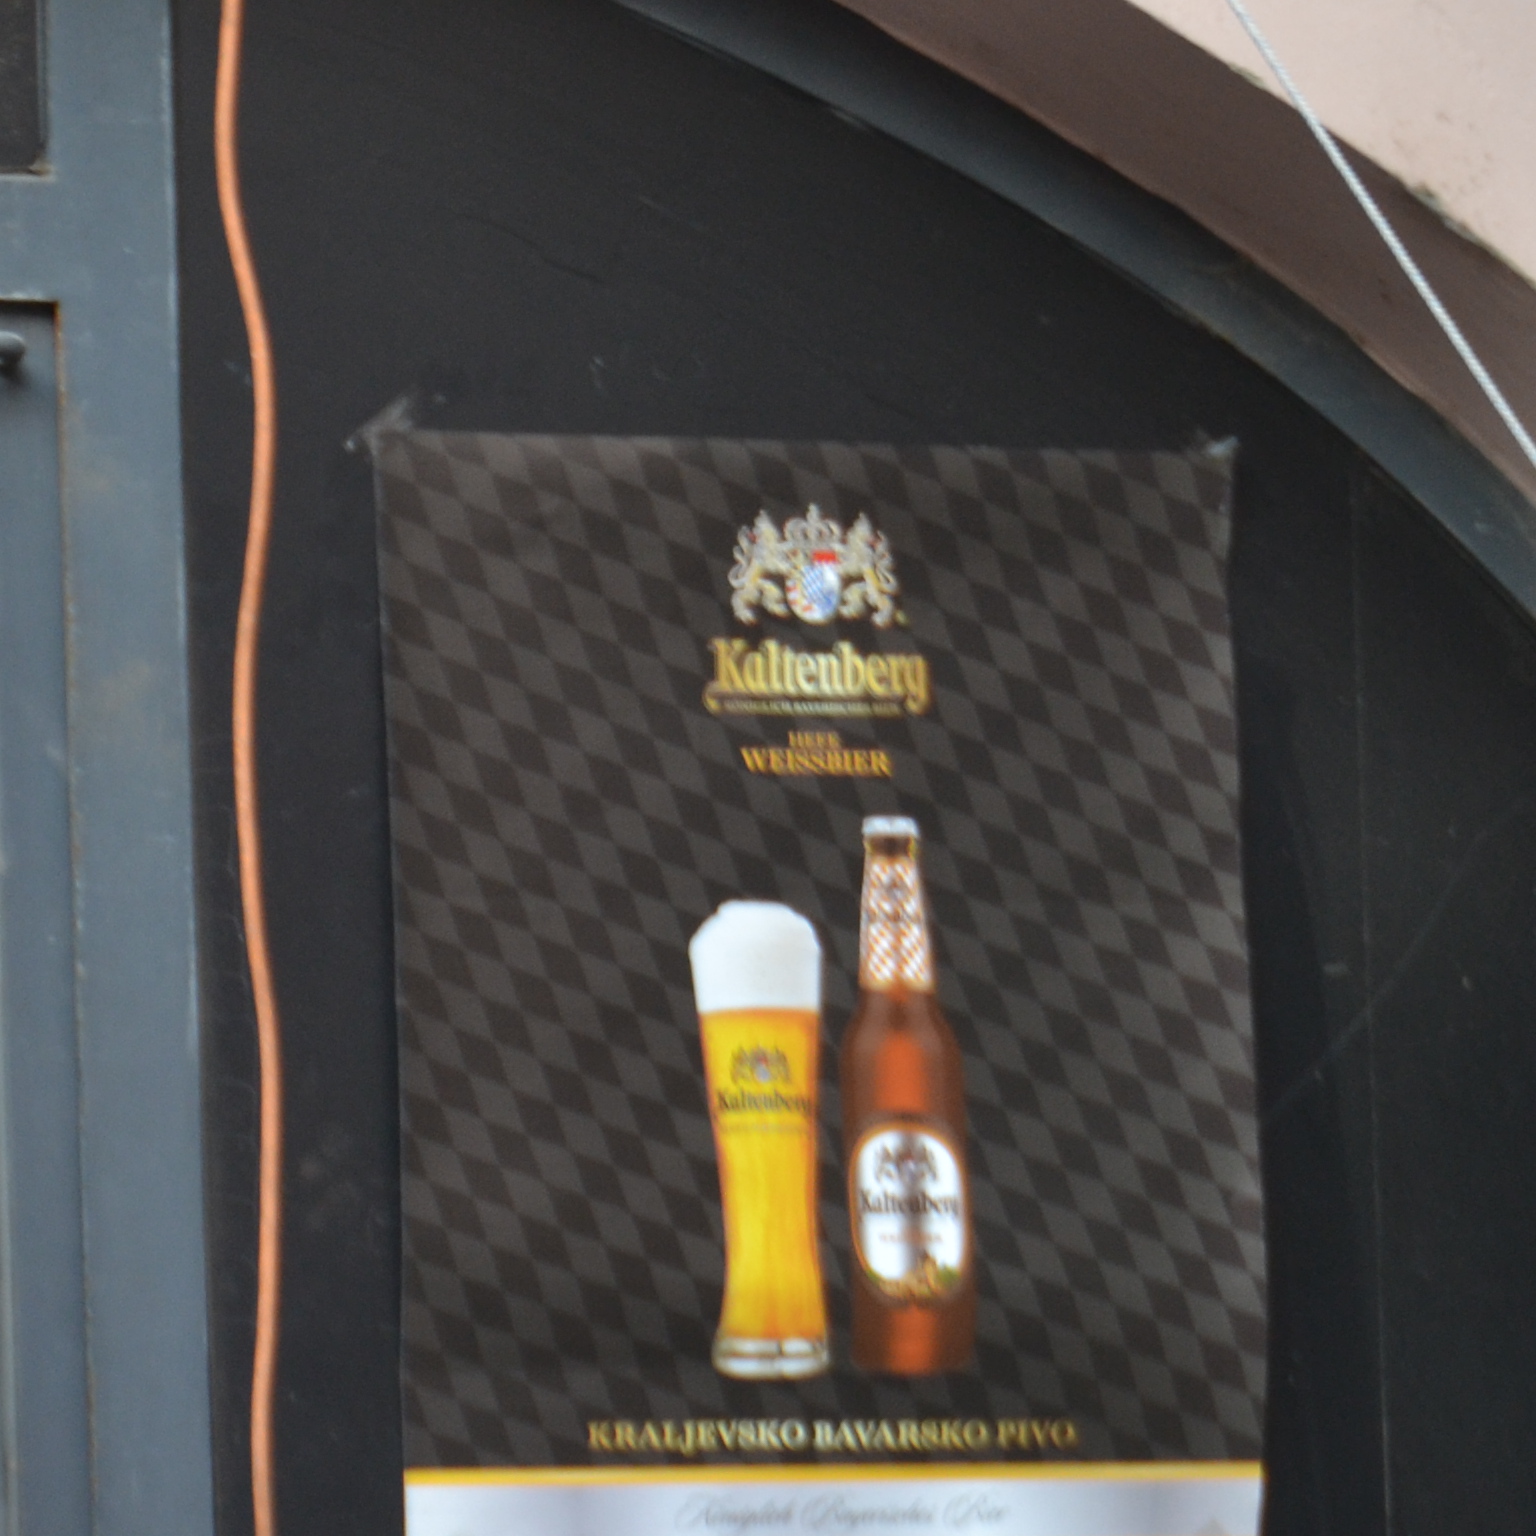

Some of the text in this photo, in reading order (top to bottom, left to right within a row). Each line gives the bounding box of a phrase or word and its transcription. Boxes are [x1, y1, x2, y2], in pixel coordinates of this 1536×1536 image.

[702, 637, 933, 716] Kaltenberg
[586, 1418, 1080, 1456] KRALJEVSKO BAVARSKO PIVO
